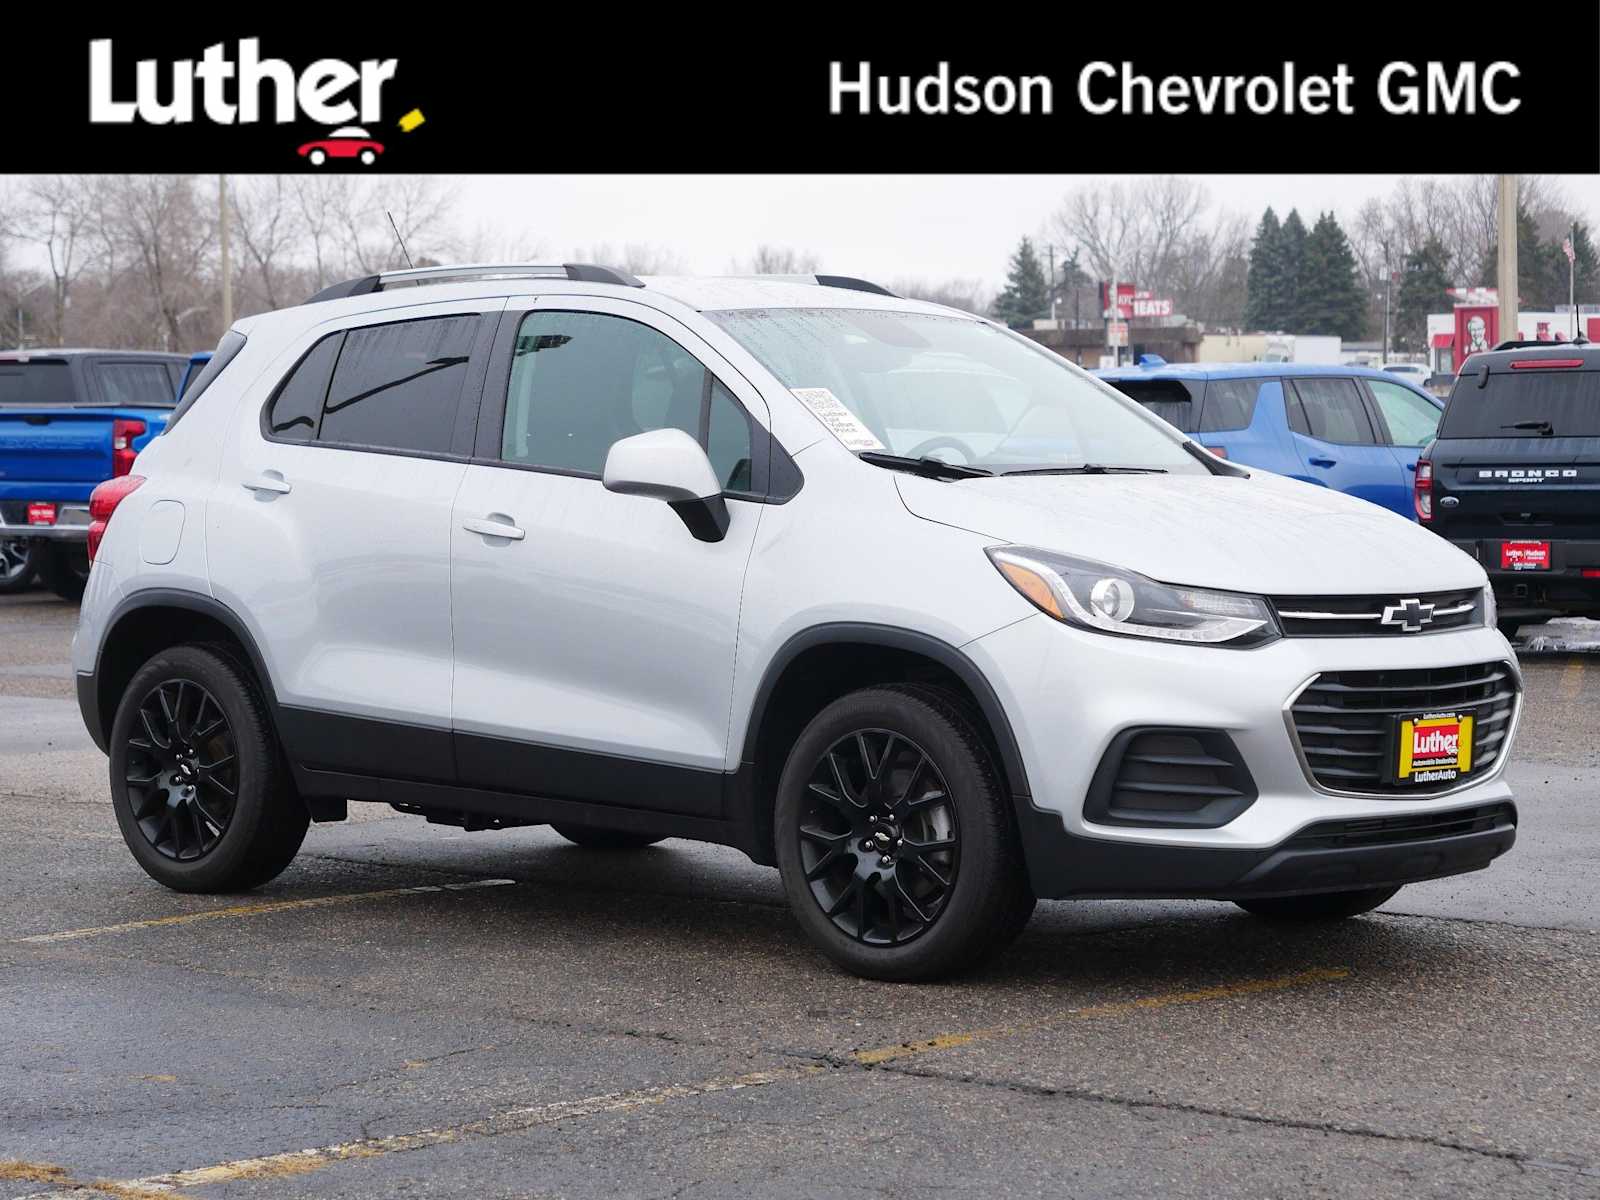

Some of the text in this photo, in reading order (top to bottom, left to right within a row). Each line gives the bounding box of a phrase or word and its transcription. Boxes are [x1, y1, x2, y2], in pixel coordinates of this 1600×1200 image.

[1479, 470, 1577, 478] BRONCO
[1414, 730, 1458, 754] Luther
[1415, 770, 1456, 782] LutherAuto
